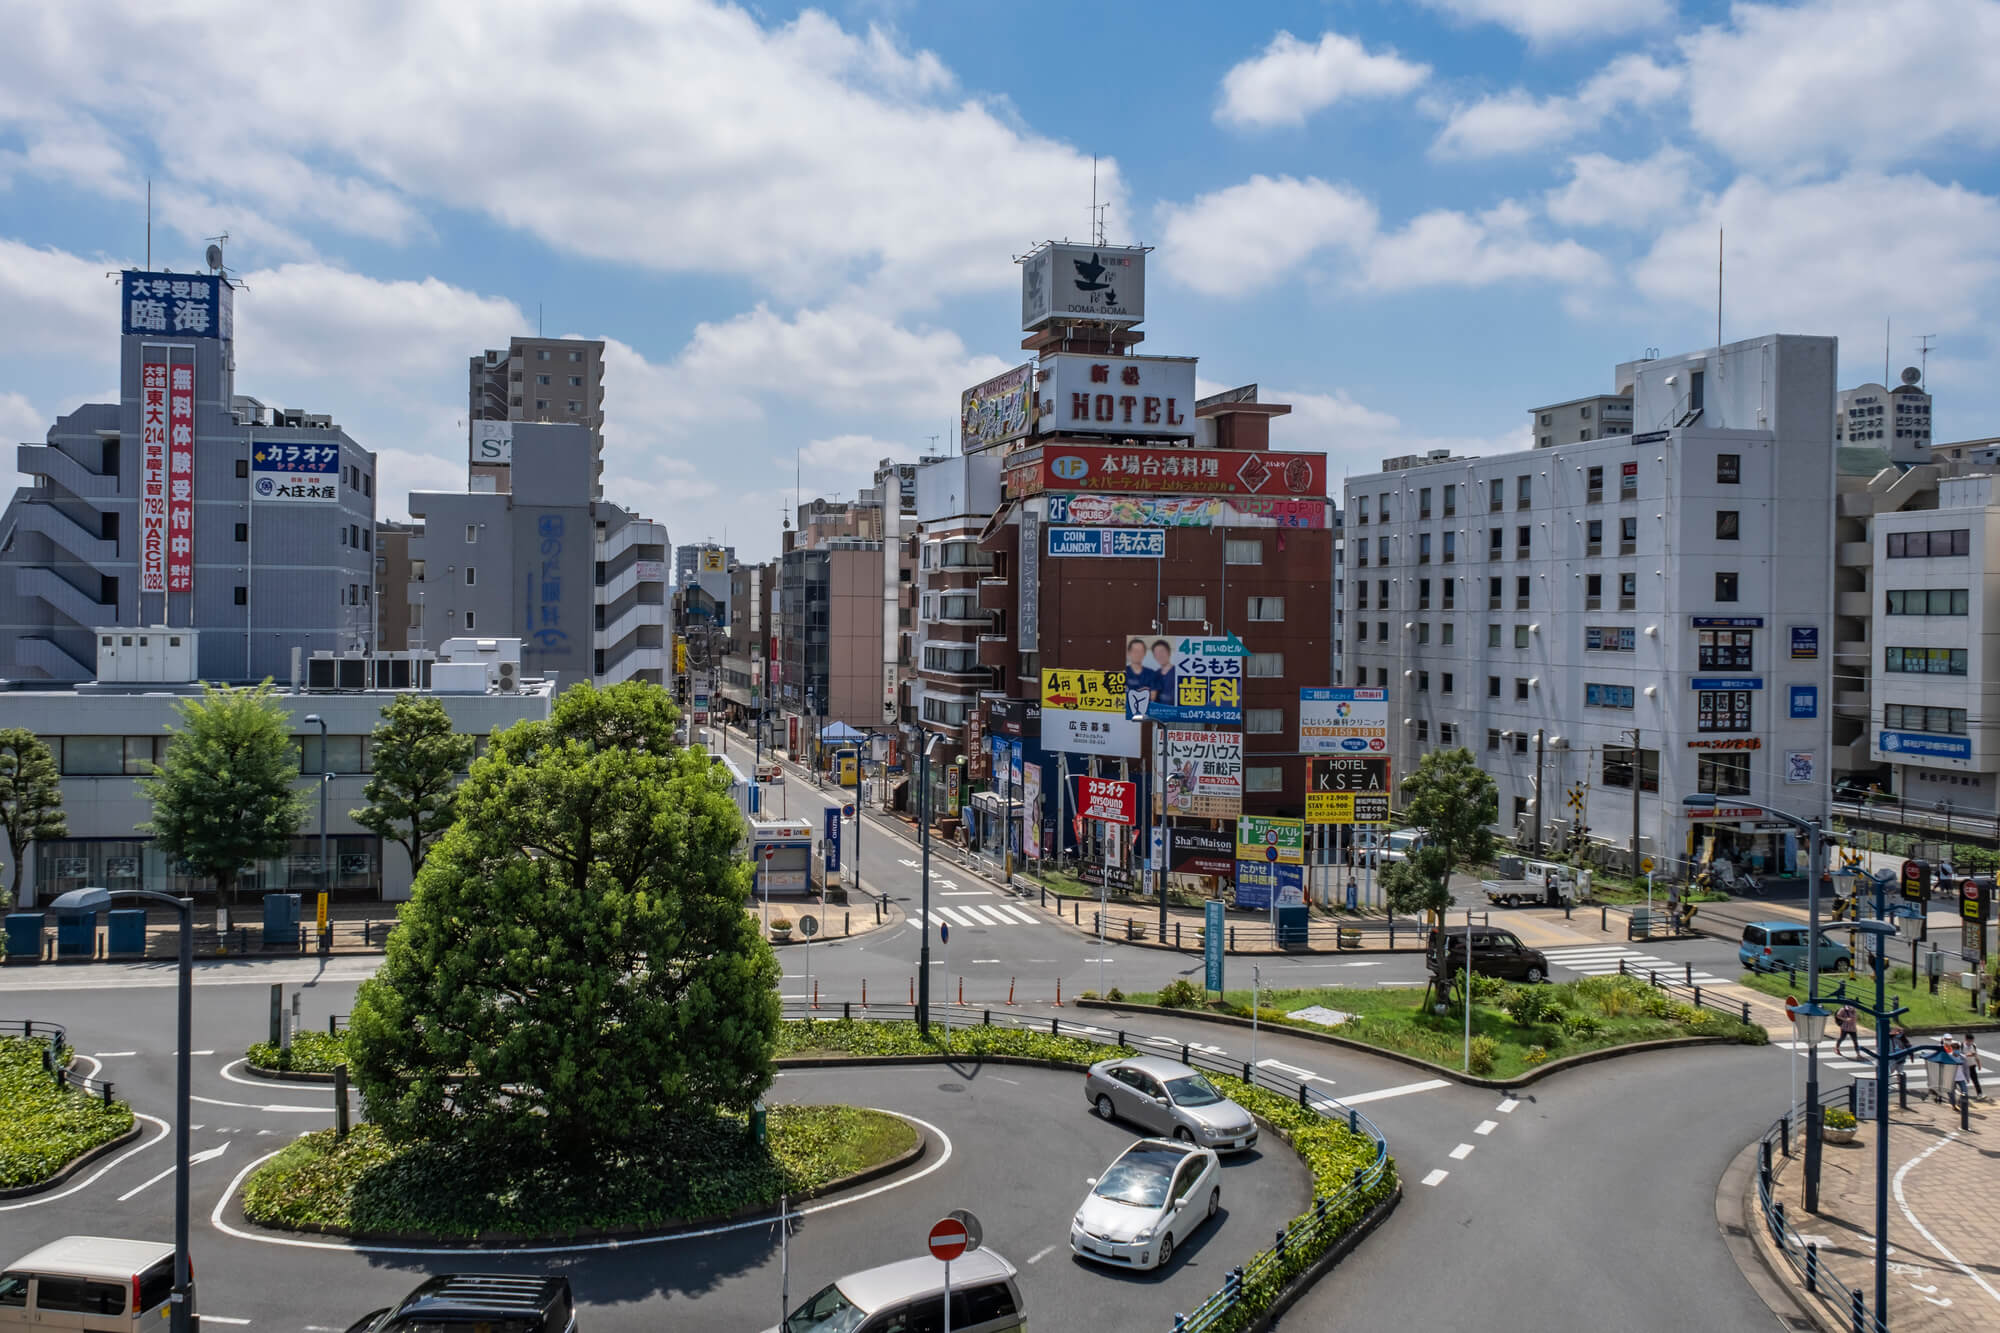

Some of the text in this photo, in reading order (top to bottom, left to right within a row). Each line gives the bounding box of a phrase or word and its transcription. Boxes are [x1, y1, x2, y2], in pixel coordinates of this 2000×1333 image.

[131, 279, 210, 299] 大学受験
[131, 299, 210, 332] 臨海
[146, 390, 164, 425] 東大
[1072, 393, 1184, 425] HOTEL
[145, 427, 165, 443] 214
[267, 445, 338, 463] カラオケ
[172, 368, 192, 557] 無料体験受付中
[1058, 460, 1082, 475] 1F
[1101, 454, 1219, 478] 本場台湾料理
[276, 485, 337, 498] 大庄水産
[144, 498, 164, 514] 792
[1051, 500, 1066, 519] 2F
[1077, 510, 1108, 519] HOUSE
[1063, 531, 1086, 541] COIN
[145, 517, 163, 573] MARCH
[1054, 542, 1097, 553] LAUNDRY
[144, 574, 162, 590] 1282
[171, 578, 189, 588] 4F
[1179, 638, 1202, 655] 4F
[1179, 658, 1240, 674] くらもち
[1178, 676, 1240, 708] 歯科
[1080, 697, 1112, 707] パチンコ
[1069, 721, 1110, 732] 広告募集
[1302, 718, 1385, 726] にじいろ歯科クリニック
[970, 710, 980, 770] 新松戸ホテル
[1203, 761, 1241, 776] 新松戸
[1330, 760, 1368, 770] HOTEL
[1089, 781, 1125, 797] カラオケ
[1090, 795, 1124, 808] JOYSOUND
[1175, 835, 1232, 849] Sha Maison
[1240, 864, 1268, 874] たかせ
